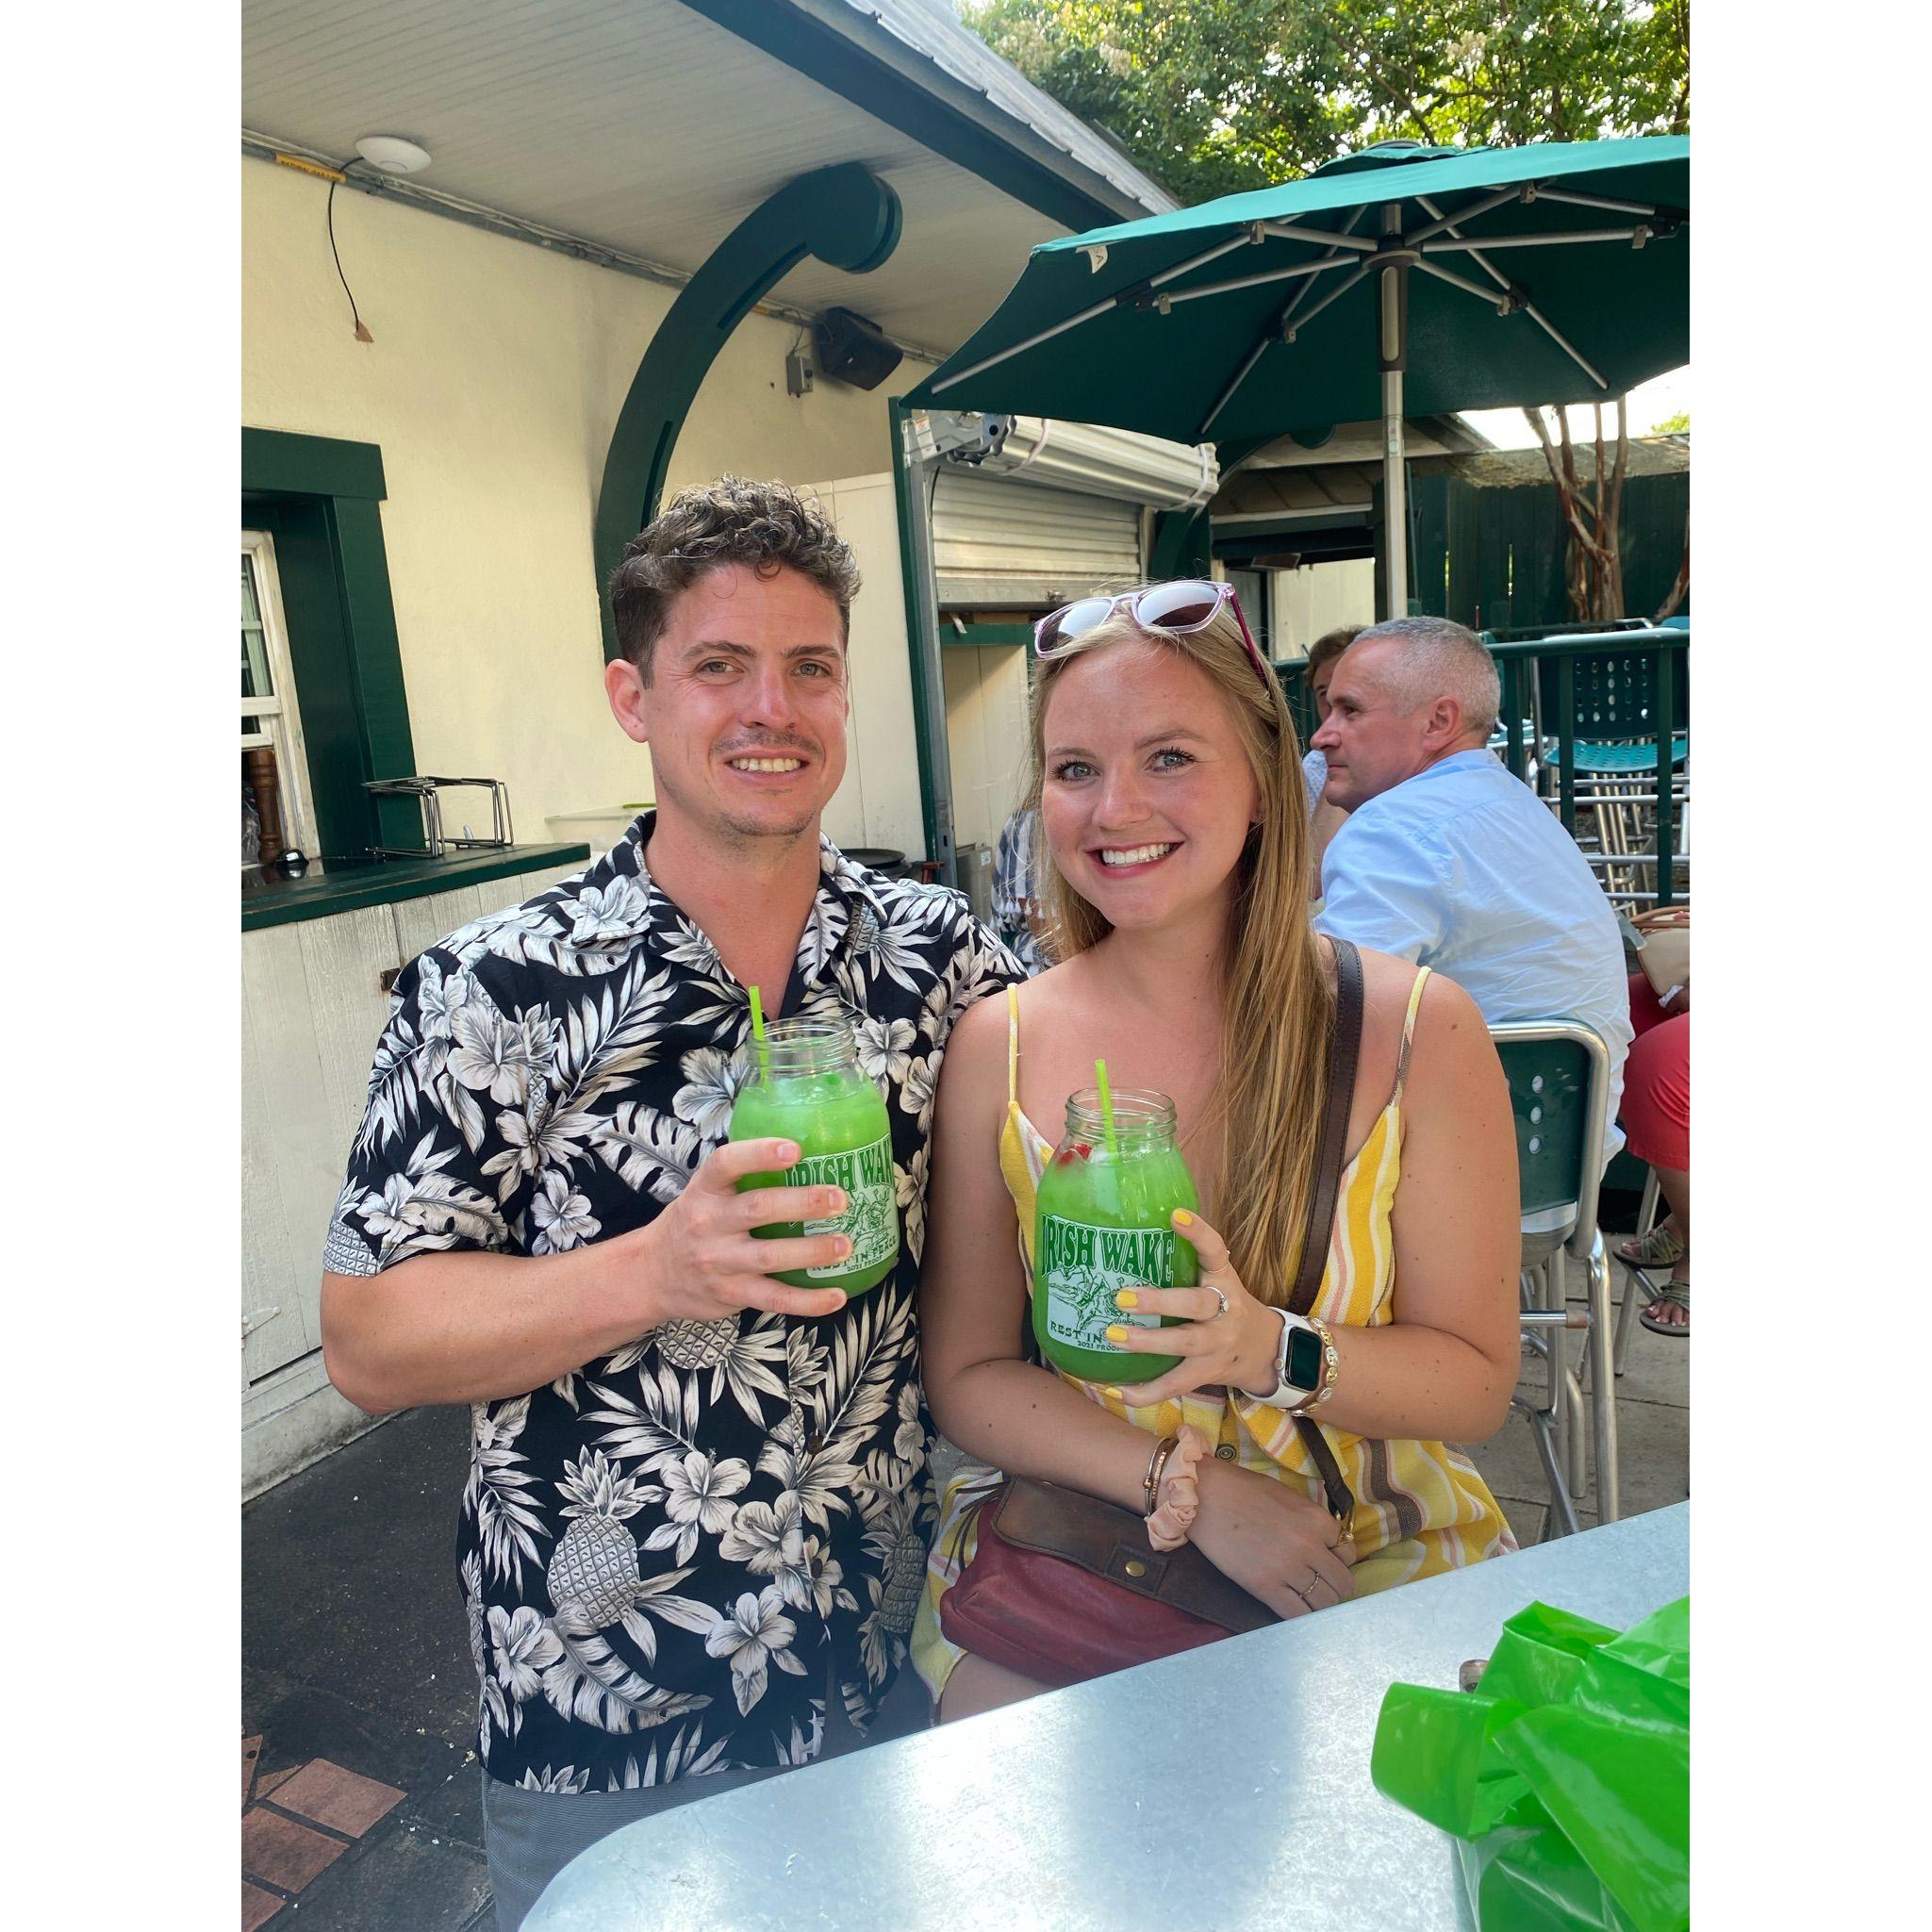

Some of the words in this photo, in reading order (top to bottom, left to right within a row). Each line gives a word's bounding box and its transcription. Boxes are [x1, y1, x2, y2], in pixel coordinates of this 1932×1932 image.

[857, 1134, 894, 1188] WAK
[1041, 1213, 1097, 1277] IRISH
[1099, 1230, 1175, 1288] WAKE
[1050, 1321, 1082, 1339] REST
[1087, 1331, 1103, 1344] IN
[1077, 1340, 1094, 1349] 2021
